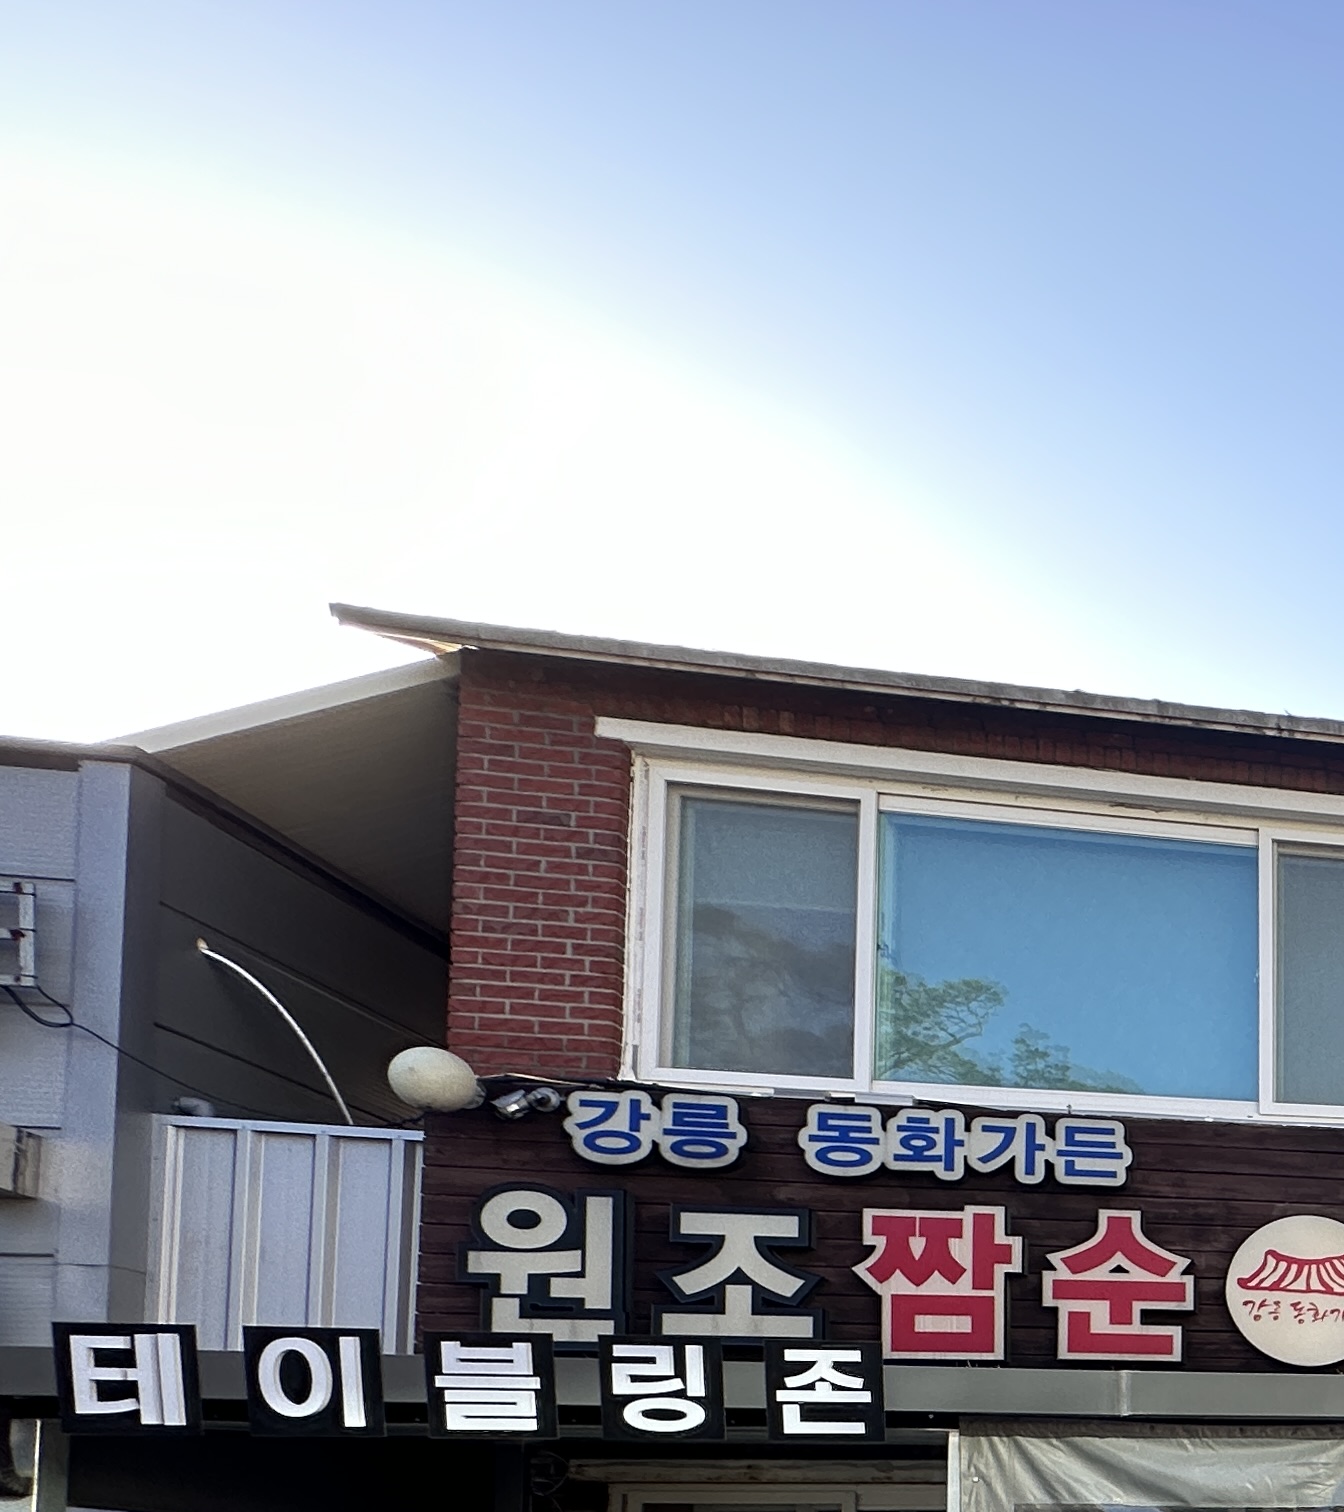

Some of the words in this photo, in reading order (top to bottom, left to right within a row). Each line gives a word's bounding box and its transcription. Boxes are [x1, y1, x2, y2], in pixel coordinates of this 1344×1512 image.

[571, 1094, 743, 1166] 강릉
[806, 1106, 1130, 1185] 동화가든
[1242, 1298, 1282, 1322] 강릉
[68, 1332, 874, 1437] 테이블링존
